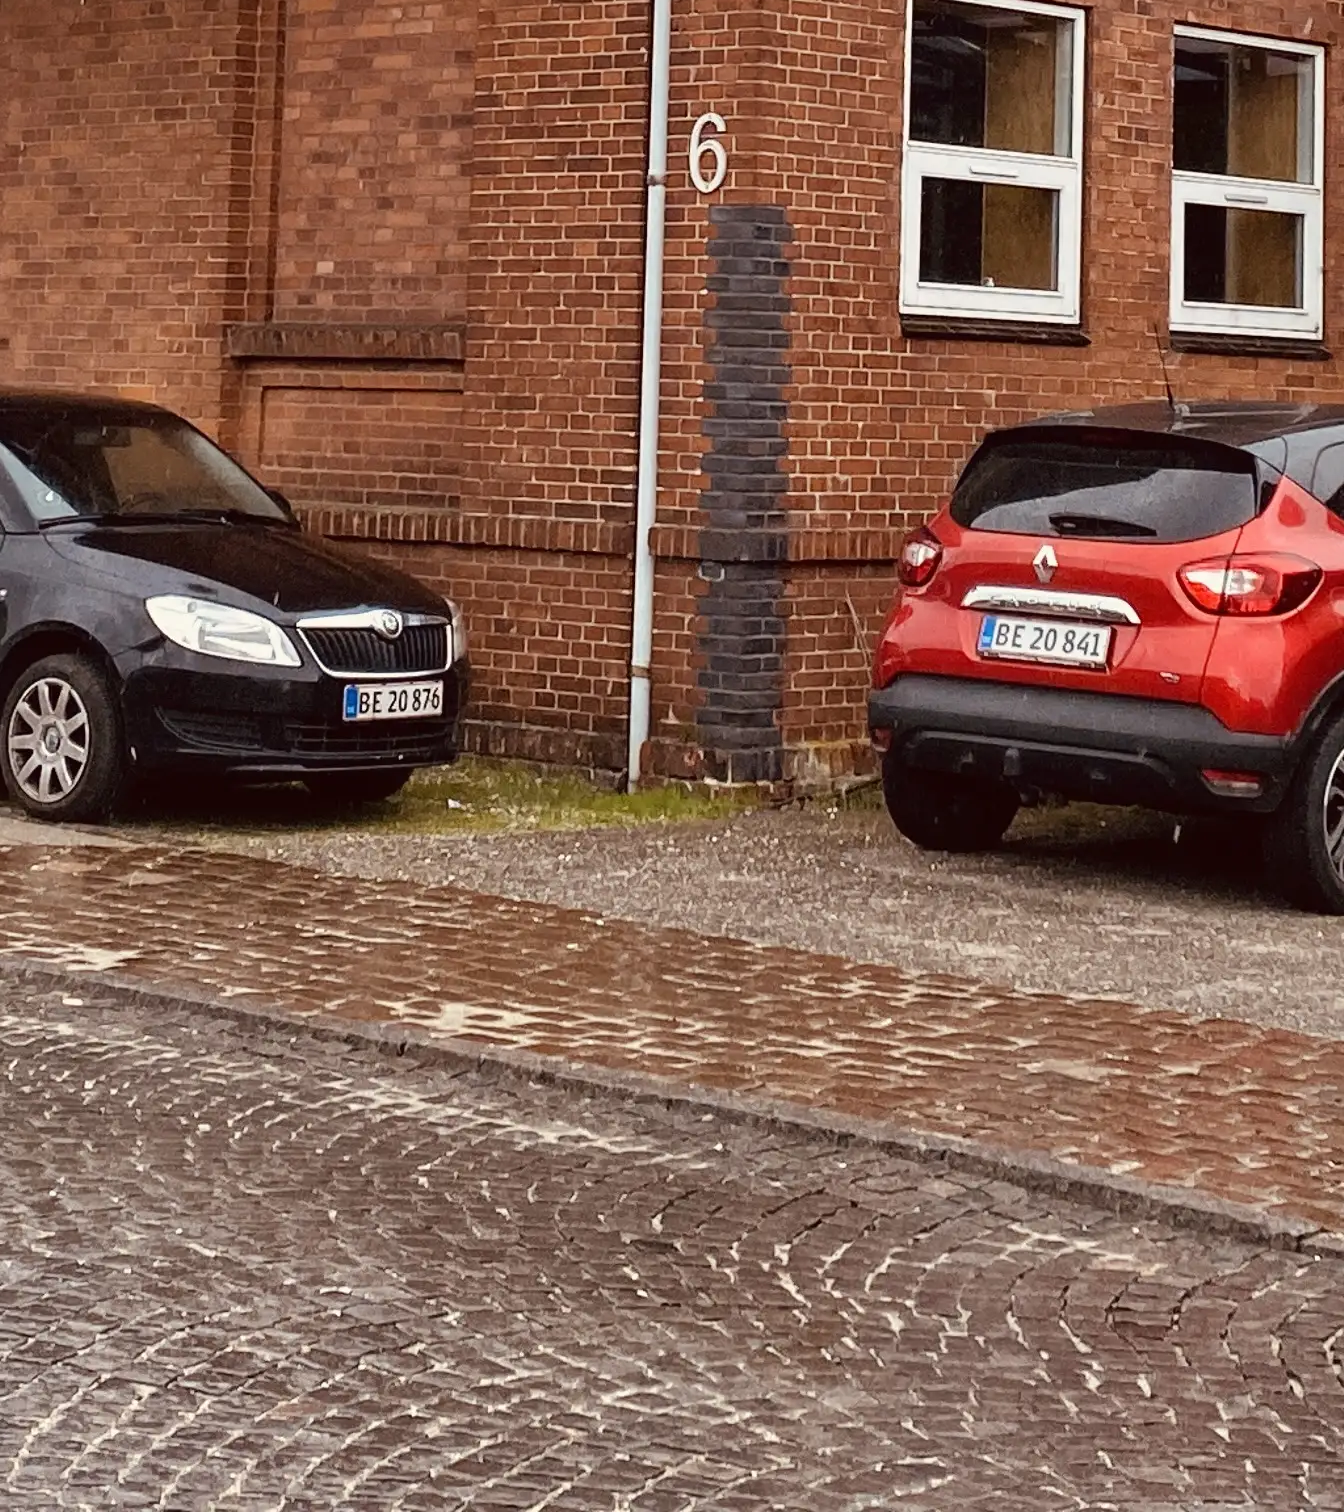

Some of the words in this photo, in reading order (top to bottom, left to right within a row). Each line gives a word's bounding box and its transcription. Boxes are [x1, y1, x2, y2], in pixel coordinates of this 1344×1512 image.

[688, 112, 728, 193] 6
[995, 623, 1026, 648] BE
[1029, 626, 1058, 652] 20
[1062, 629, 1101, 657] 841
[359, 691, 383, 714] BE
[387, 690, 408, 713] 20
[412, 688, 440, 712] 876
